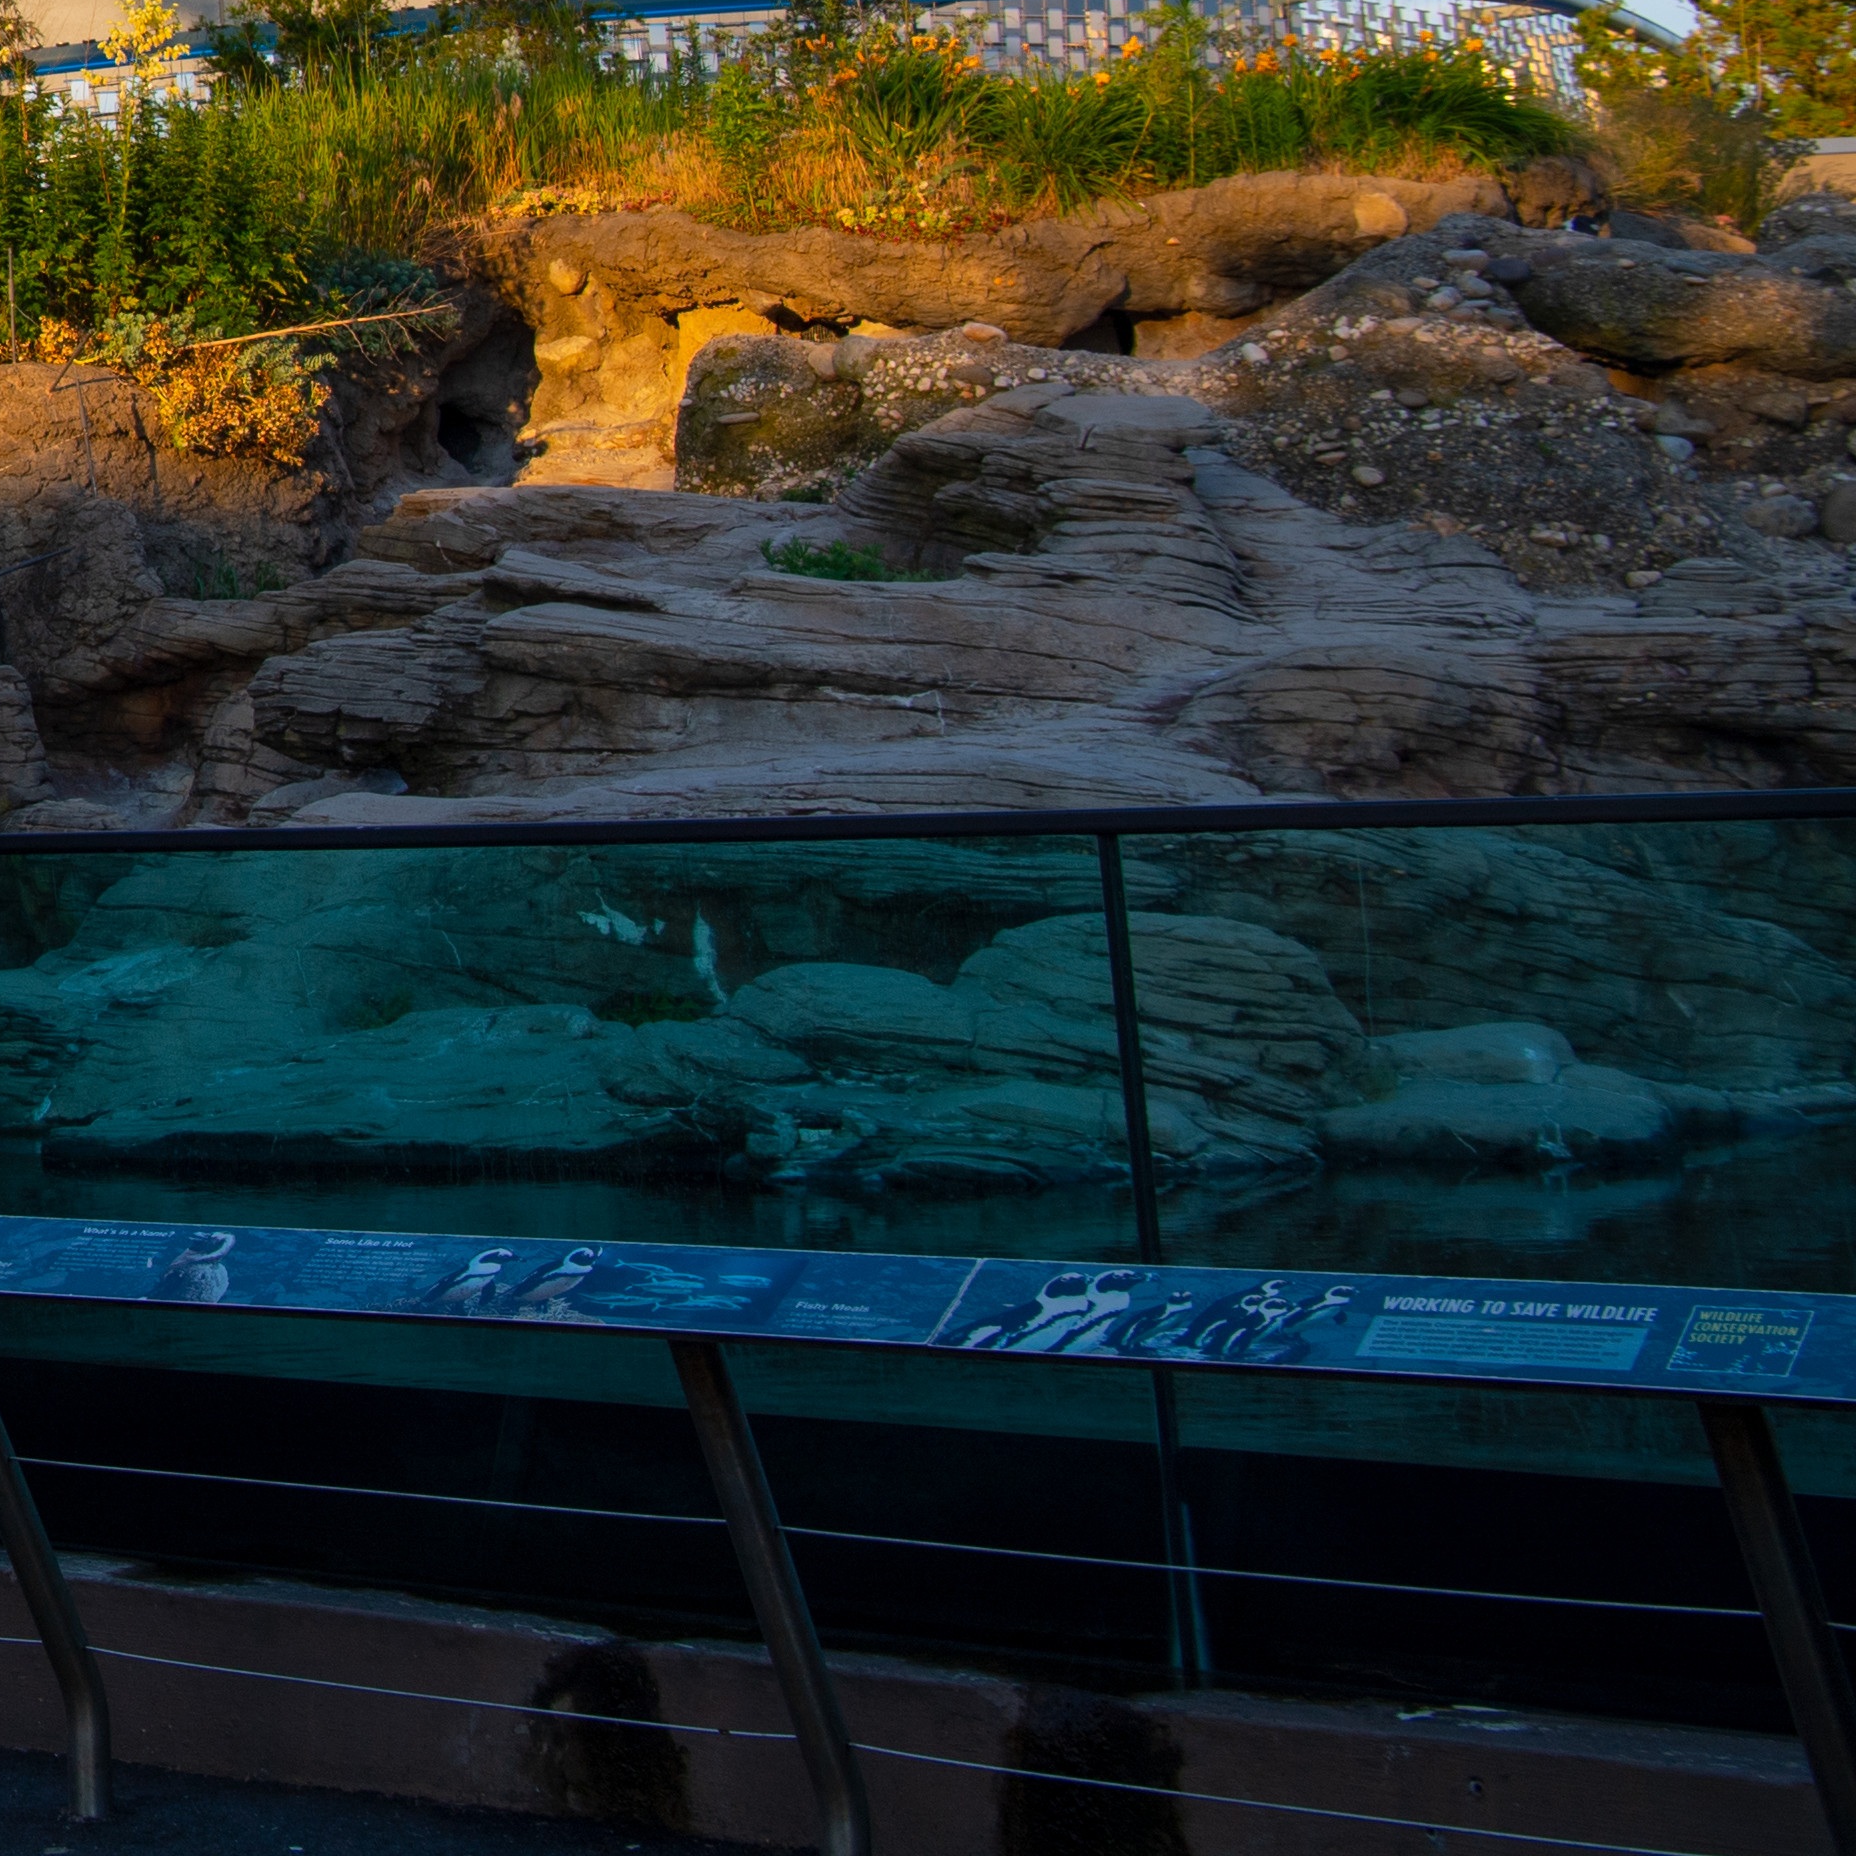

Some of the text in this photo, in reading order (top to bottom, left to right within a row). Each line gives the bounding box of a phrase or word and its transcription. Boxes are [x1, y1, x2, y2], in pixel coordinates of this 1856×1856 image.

[83, 1227, 115, 1235] What's
[139, 1229, 176, 1238] Name?
[325, 1237, 355, 1246] Some
[357, 1238, 380, 1247] Like
[393, 1240, 415, 1249] Hot
[795, 1301, 870, 1313] Fishy Meals
[1383, 1295, 1658, 1322] WORKING TO SAVE WILDLIFE
[1699, 1310, 1765, 1323] WILDLIFE
[1693, 1321, 1799, 1337] CONSERVATION
[1688, 1332, 1747, 1345] SOCIETY
